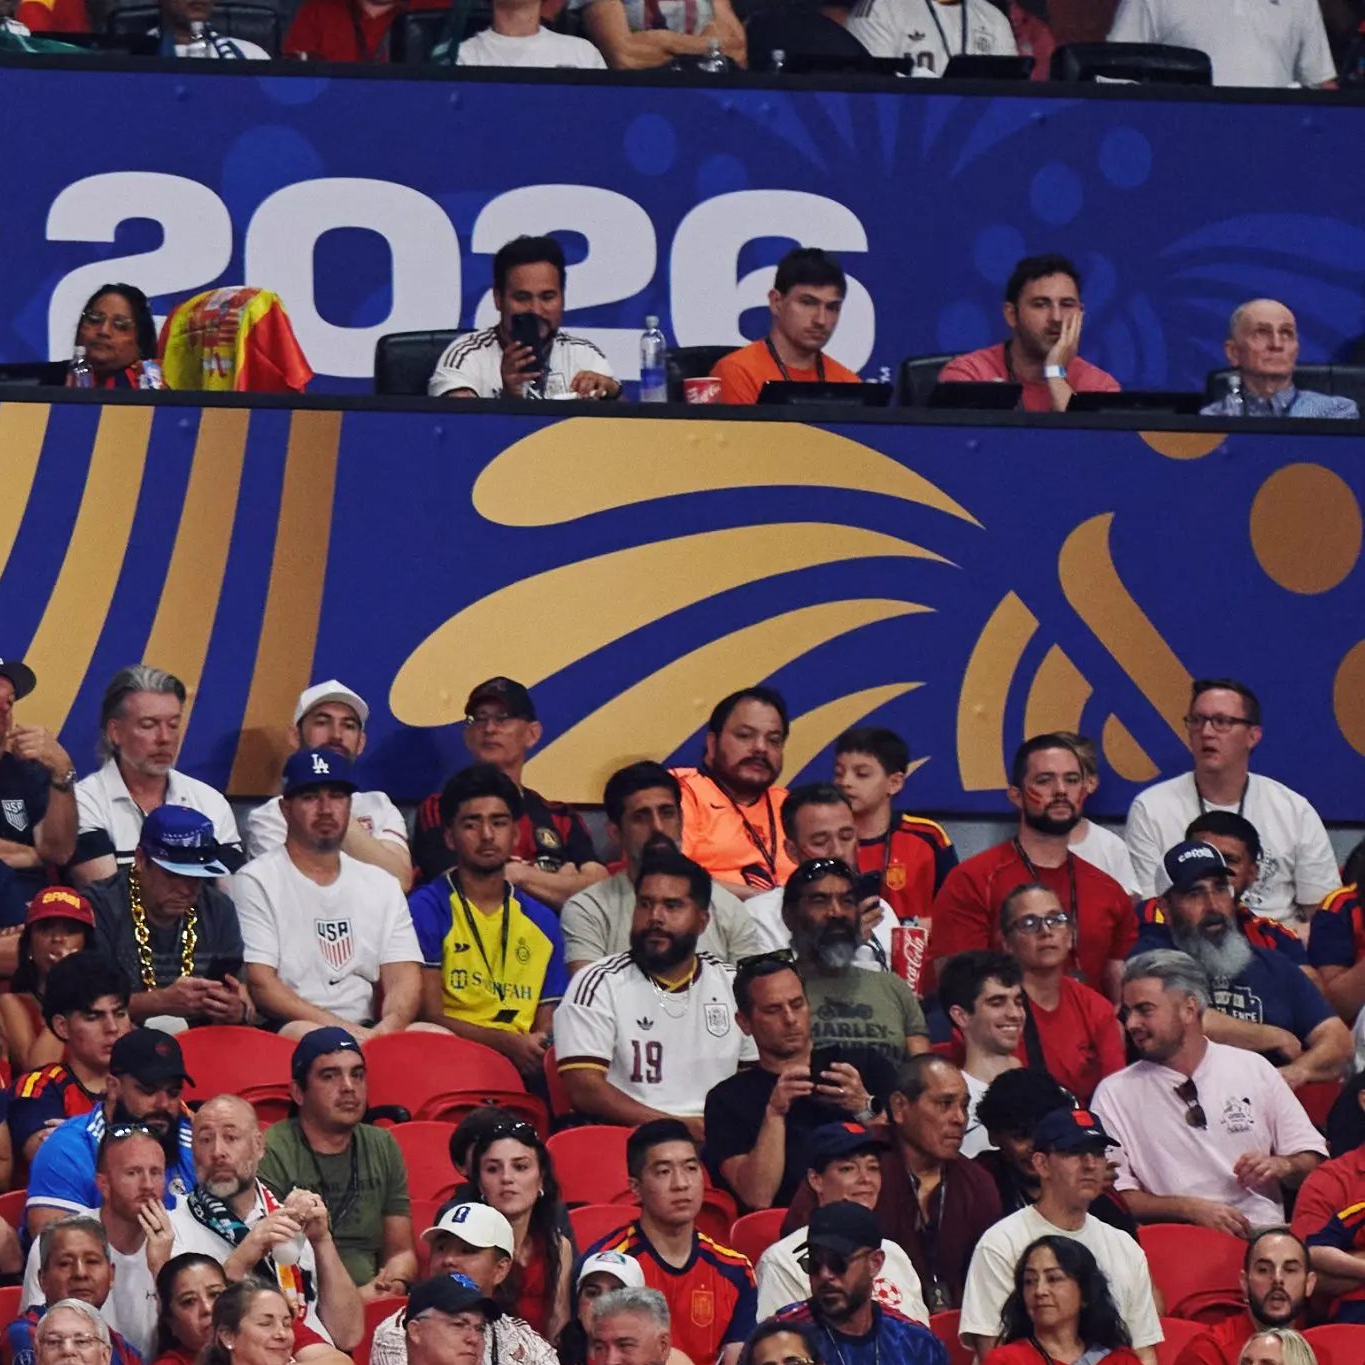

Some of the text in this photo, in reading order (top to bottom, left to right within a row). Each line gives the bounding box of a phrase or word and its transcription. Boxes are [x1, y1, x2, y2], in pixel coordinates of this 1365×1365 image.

[46, 170, 876, 381] 2026
[311, 753, 329, 774] LA
[3, 800, 25, 814] USA
[42, 891, 81, 910] SPAIN
[317, 922, 350, 942] USA
[631, 1040, 666, 1085] 19
